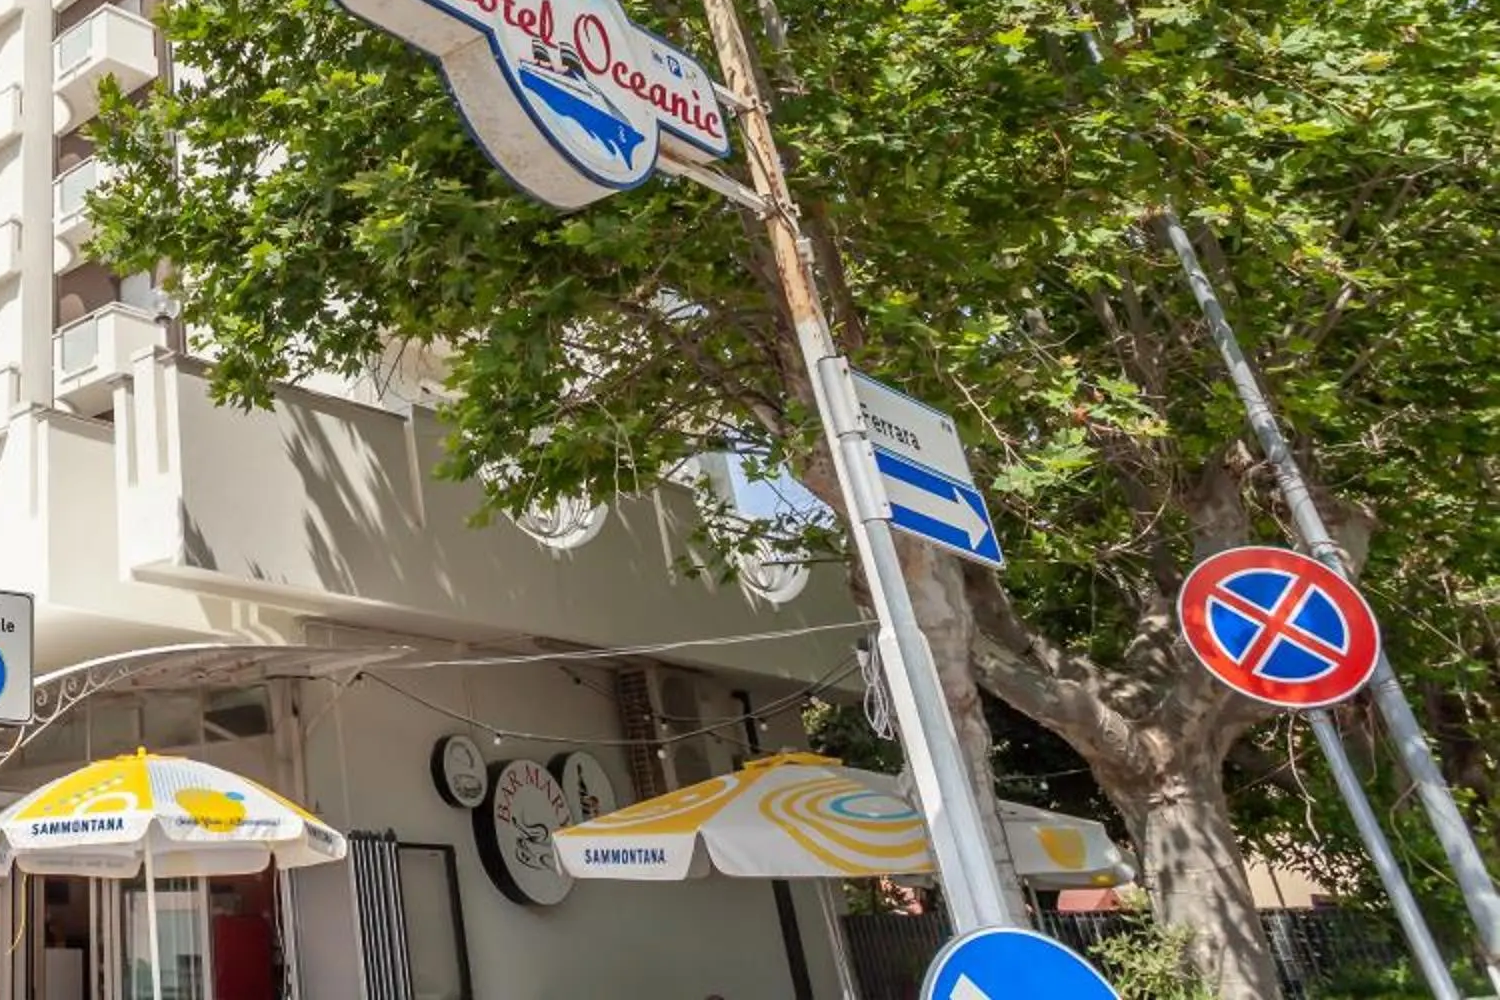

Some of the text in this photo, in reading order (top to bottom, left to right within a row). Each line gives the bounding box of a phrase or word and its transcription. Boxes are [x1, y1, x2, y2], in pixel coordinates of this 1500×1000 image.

[573, 13, 722, 138] Oceanic
[498, 769, 523, 822] BAR
[31, 818, 124, 836] SAMMONTANA
[585, 848, 666, 864] SAMMONTANA
